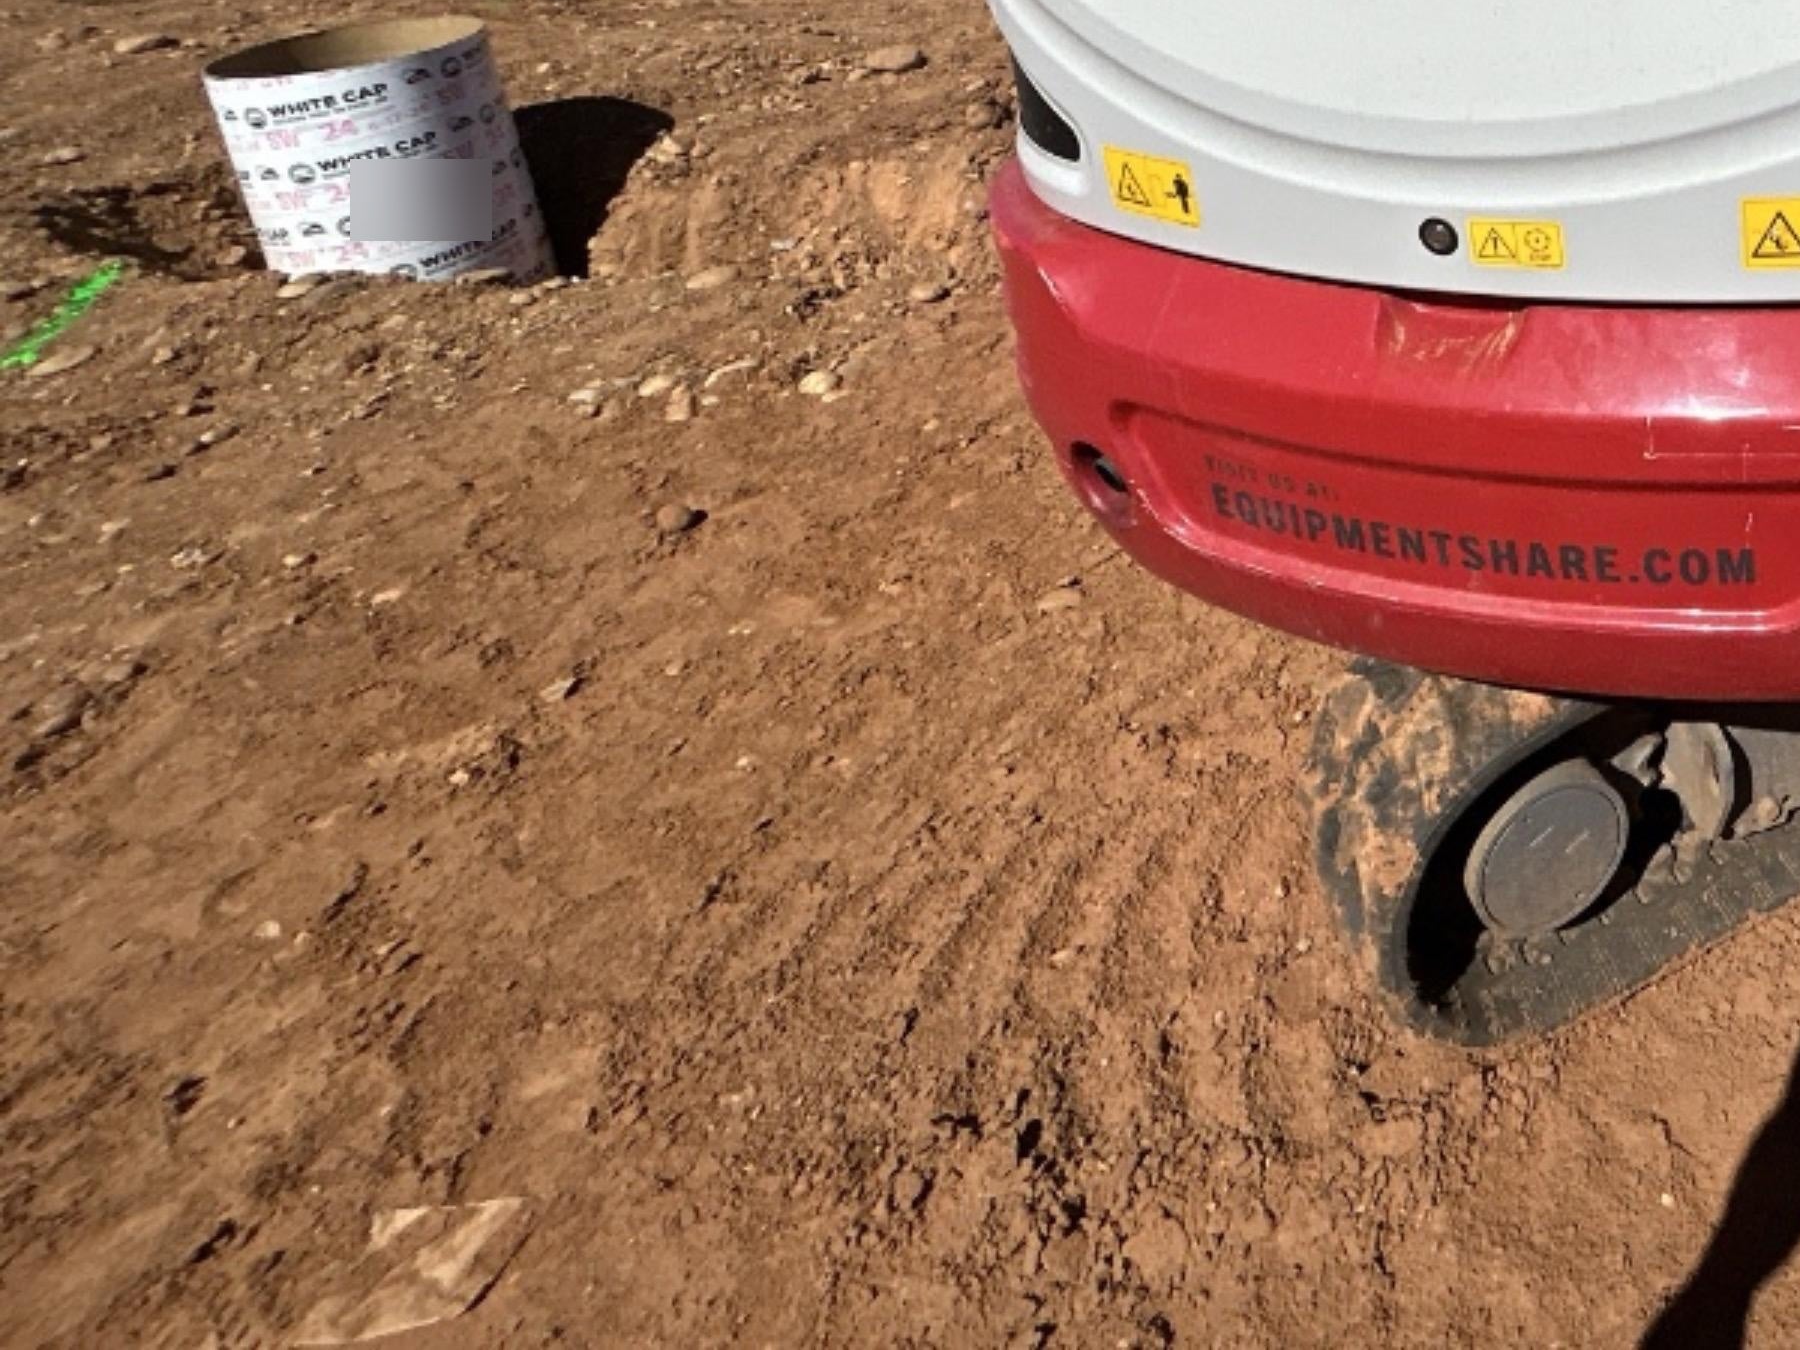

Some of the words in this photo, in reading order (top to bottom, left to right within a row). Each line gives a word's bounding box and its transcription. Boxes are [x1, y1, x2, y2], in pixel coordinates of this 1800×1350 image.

[267, 95, 338, 118] WHITE
[341, 83, 388, 104] CAP
[395, 131, 437, 152] CAP
[1268, 473, 1296, 493] US
[1211, 481, 1758, 585] EQUIPMENTSHARE.COM
